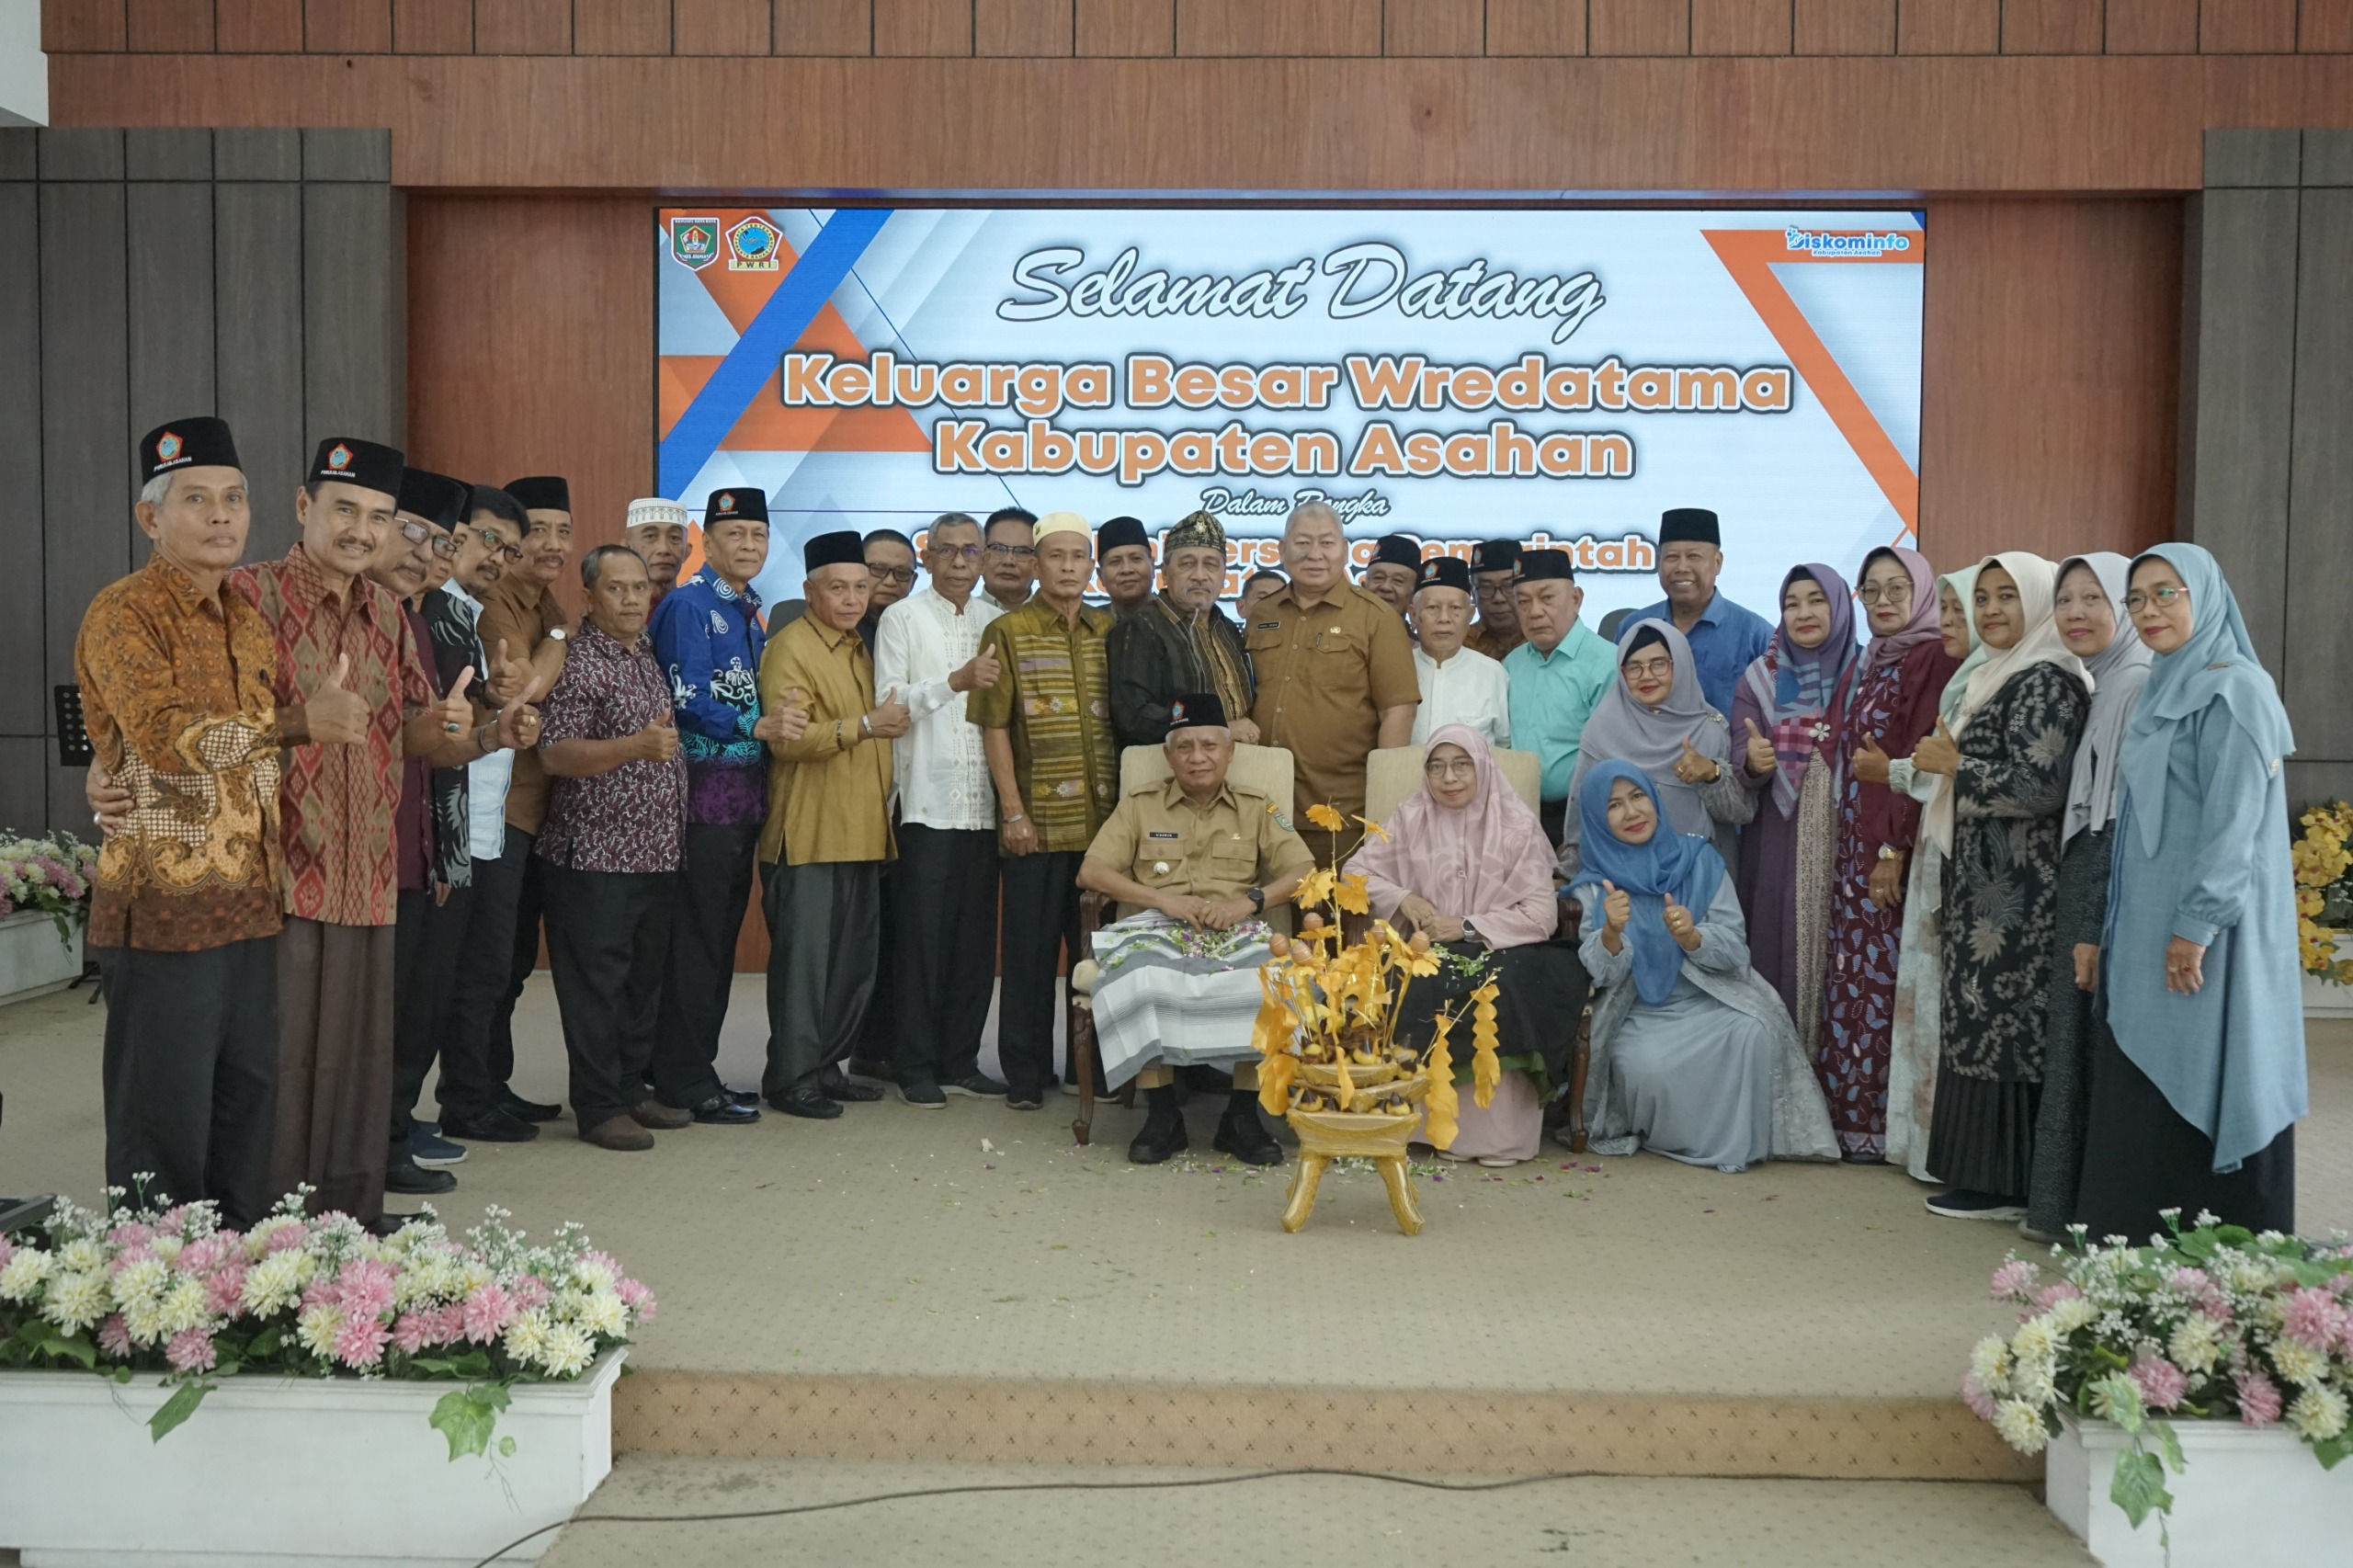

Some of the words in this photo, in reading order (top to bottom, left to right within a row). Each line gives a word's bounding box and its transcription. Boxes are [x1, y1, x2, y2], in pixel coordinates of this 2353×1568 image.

[1787, 232, 1908, 250] Diskominfo
[997, 247, 1313, 321] Selamat
[1323, 243, 1606, 344] Datang
[782, 350, 1113, 415] Keluarga
[1127, 353, 1340, 410] Besar
[1346, 354, 1791, 411] Wredatama
[935, 418, 1340, 483] Kabupaten
[1348, 421, 1634, 478] Asahan
[1201, 487, 1289, 515] Dalam
[1294, 488, 1391, 524] Rngka
